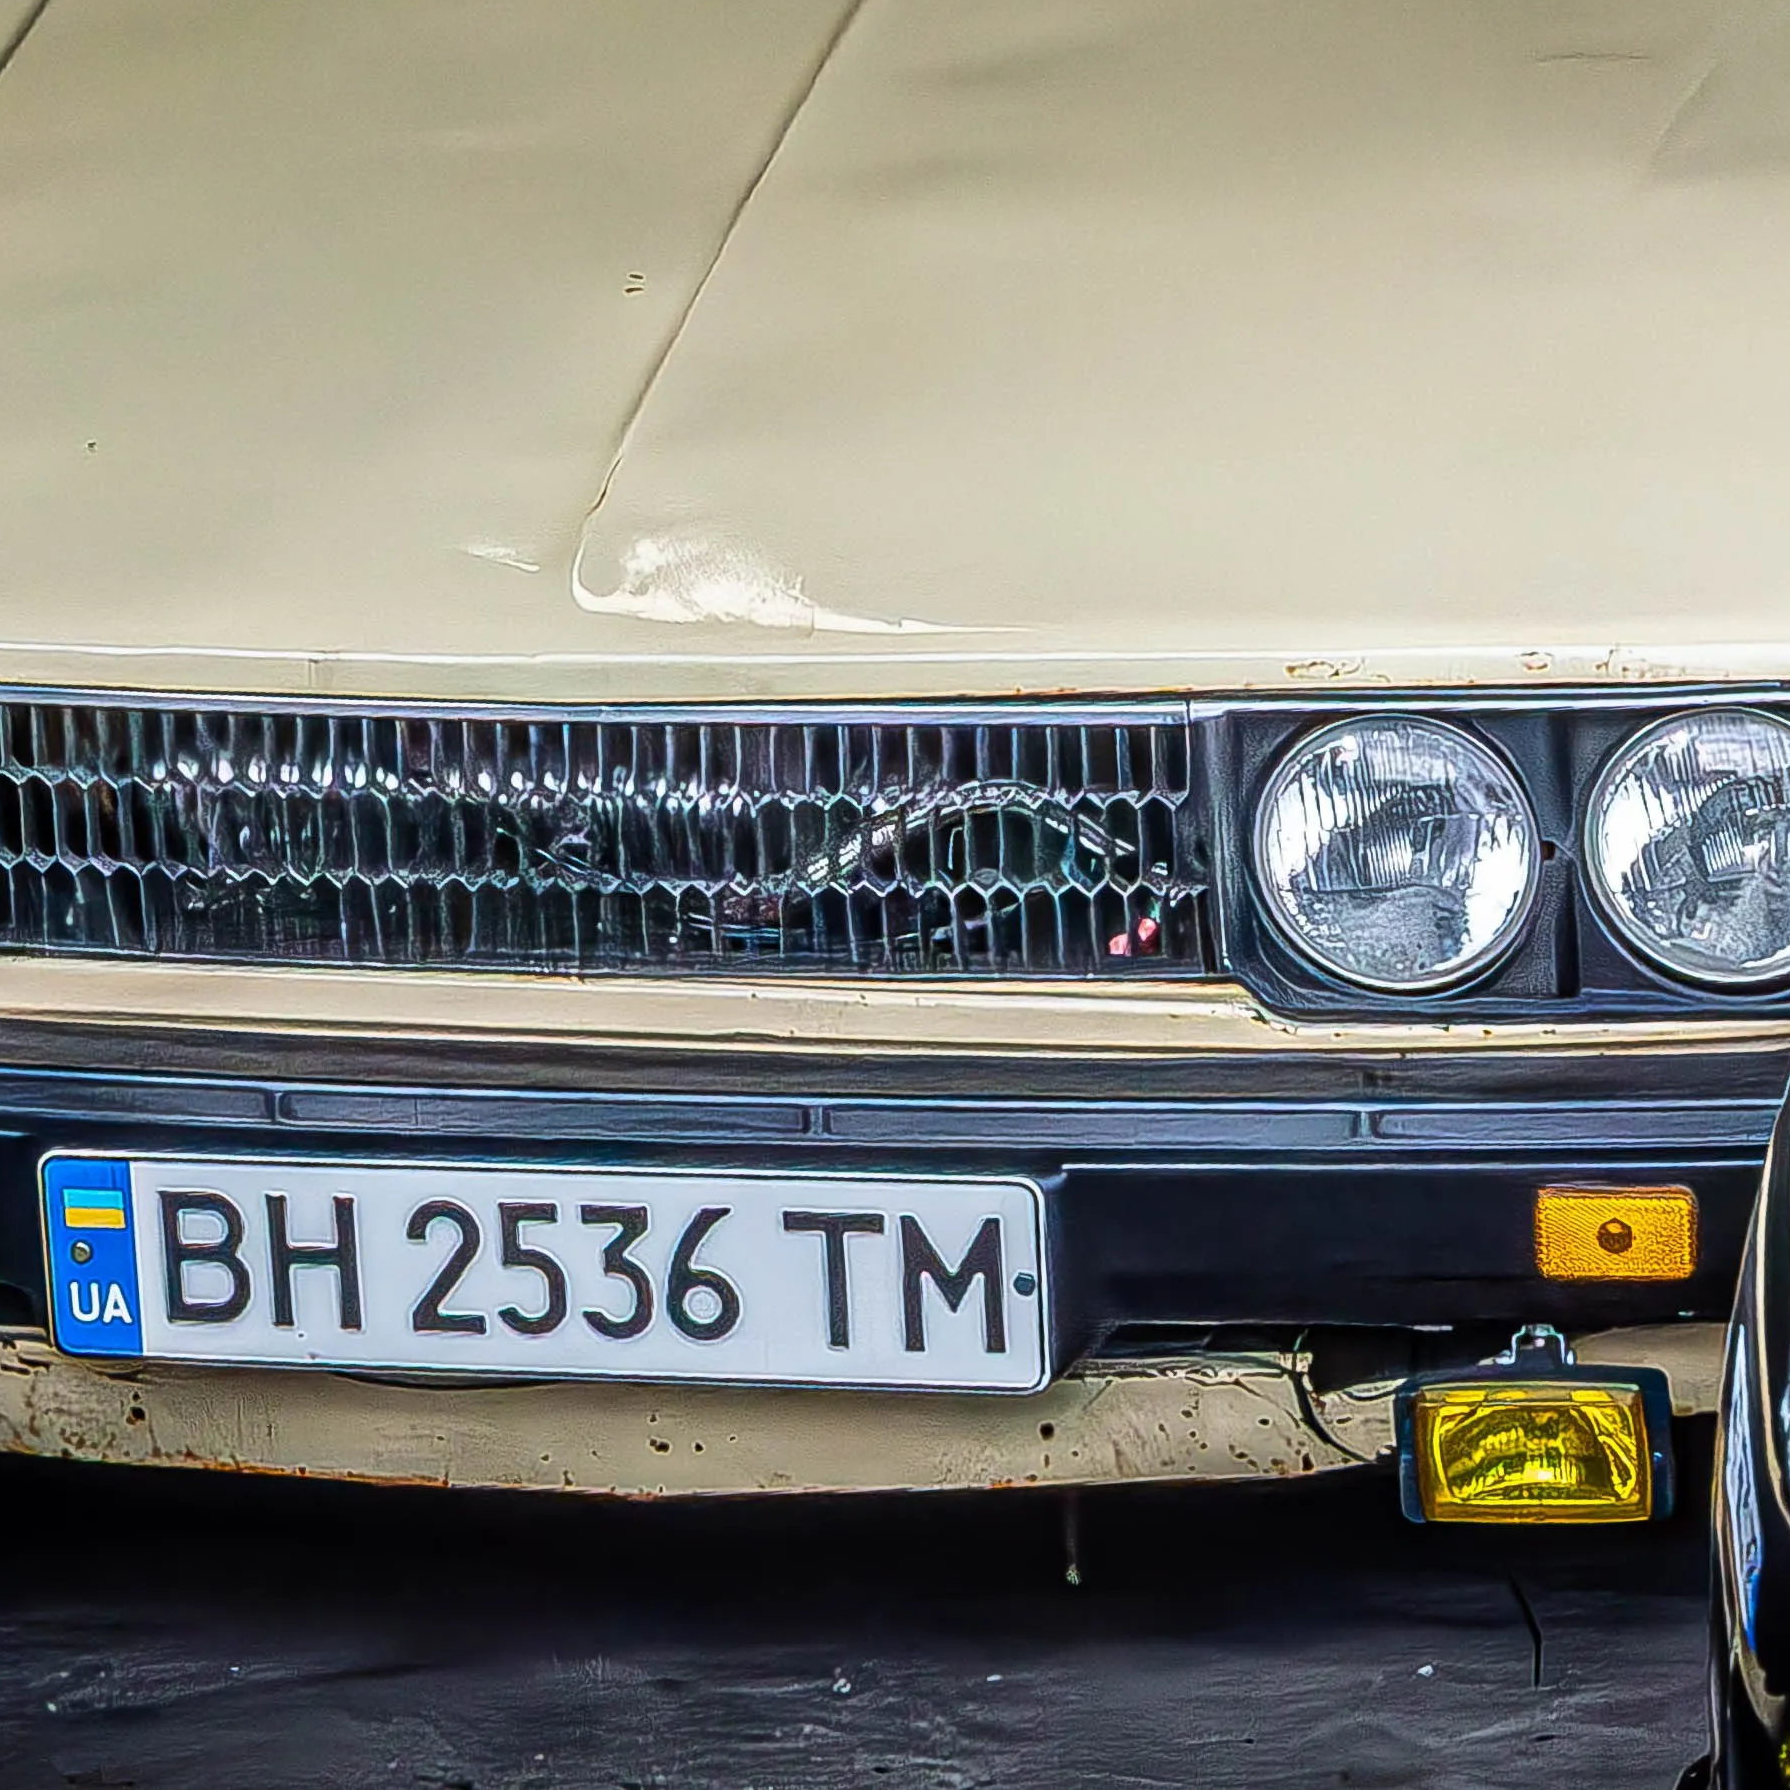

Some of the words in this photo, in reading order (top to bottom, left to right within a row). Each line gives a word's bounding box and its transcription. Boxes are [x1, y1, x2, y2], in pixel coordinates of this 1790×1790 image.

[69, 1281, 133, 1324] UA
[157, 1189, 363, 1331] BH
[407, 1198, 742, 1343] 2536
[783, 1209, 1007, 1355] TM
